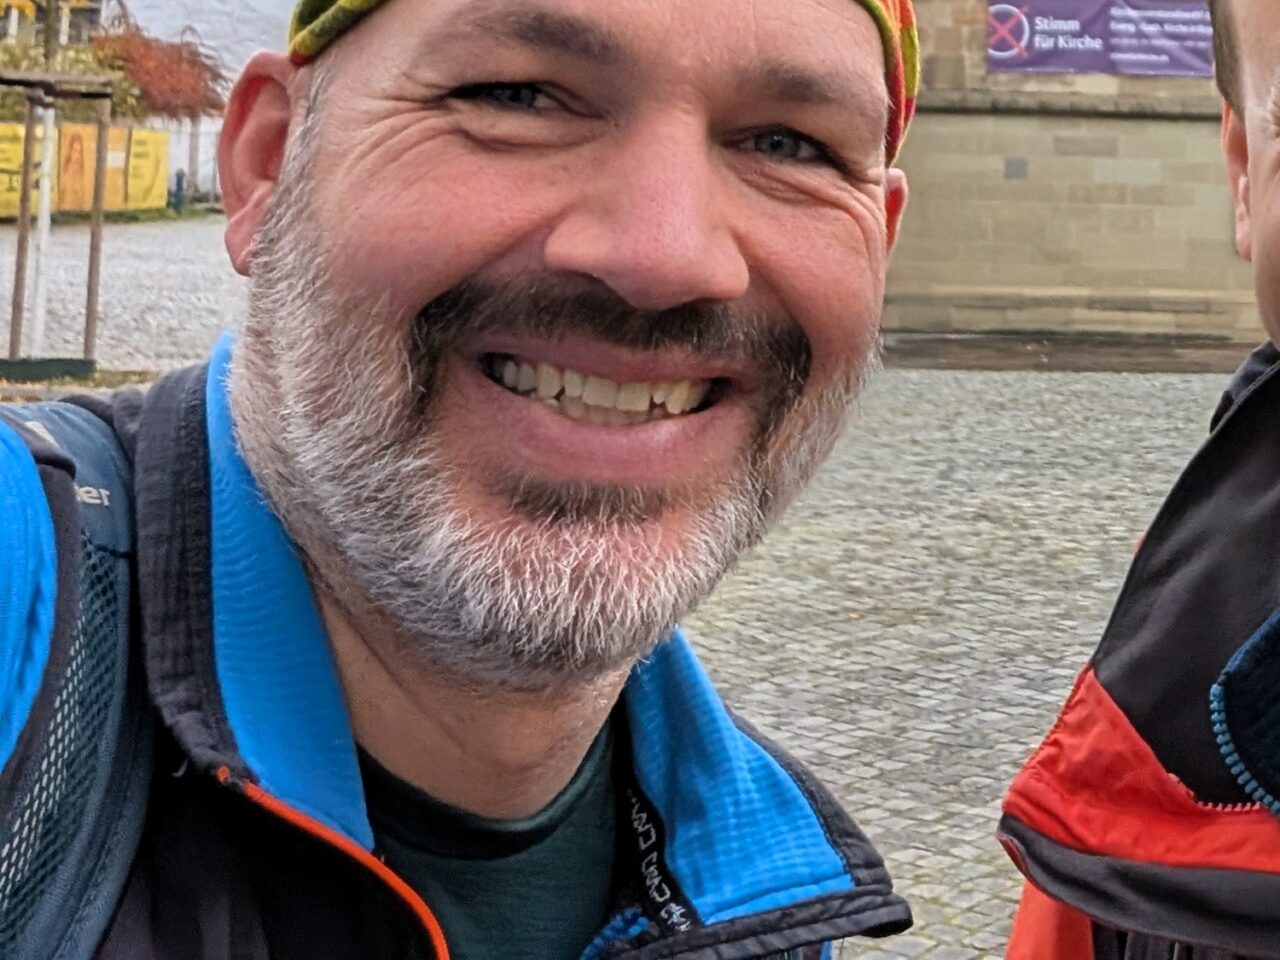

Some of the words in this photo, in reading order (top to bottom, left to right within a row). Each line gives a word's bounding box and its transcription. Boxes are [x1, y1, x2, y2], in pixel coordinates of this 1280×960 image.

[1034, 16, 1080, 31] Stimm
[1034, 33, 1055, 49] für
[1058, 33, 1103, 49] Kirche
